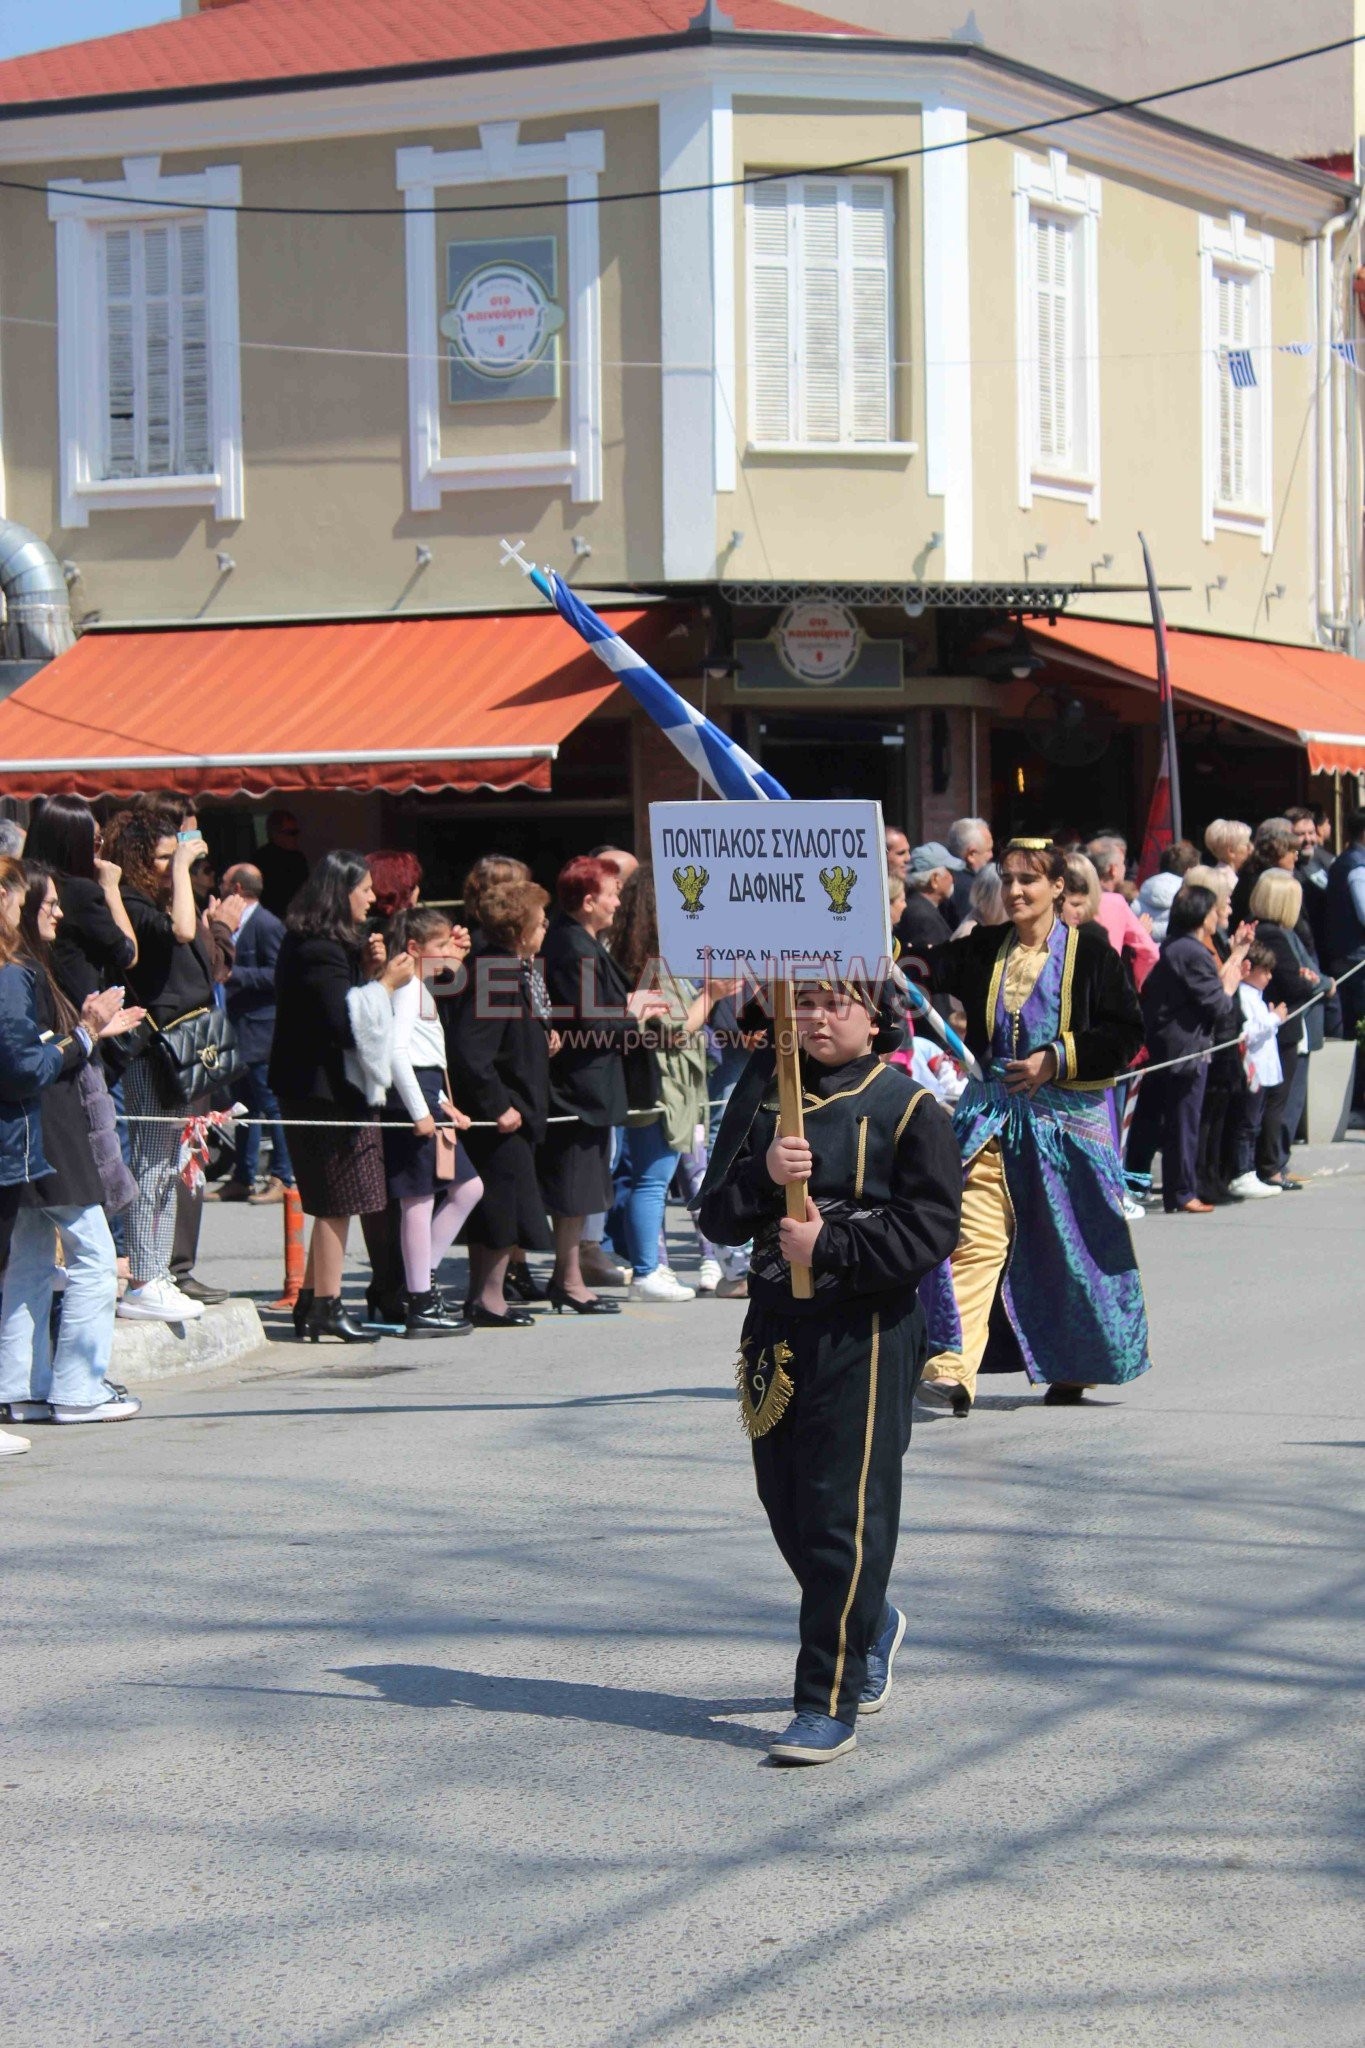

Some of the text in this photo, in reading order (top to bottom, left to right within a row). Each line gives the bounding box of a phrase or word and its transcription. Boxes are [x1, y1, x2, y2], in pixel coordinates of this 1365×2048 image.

[663, 828, 868, 858] ΠΟΝΤΙΑΚΟΣ ΣΥΛΛΟΓΟΣ
[728, 872, 806, 903] ΔΑΦΝΗΣ
[696, 948, 756, 961] ΣΚΥΔΡΑ
[780, 949, 843, 962] ΠΕΛΛΑΣ
